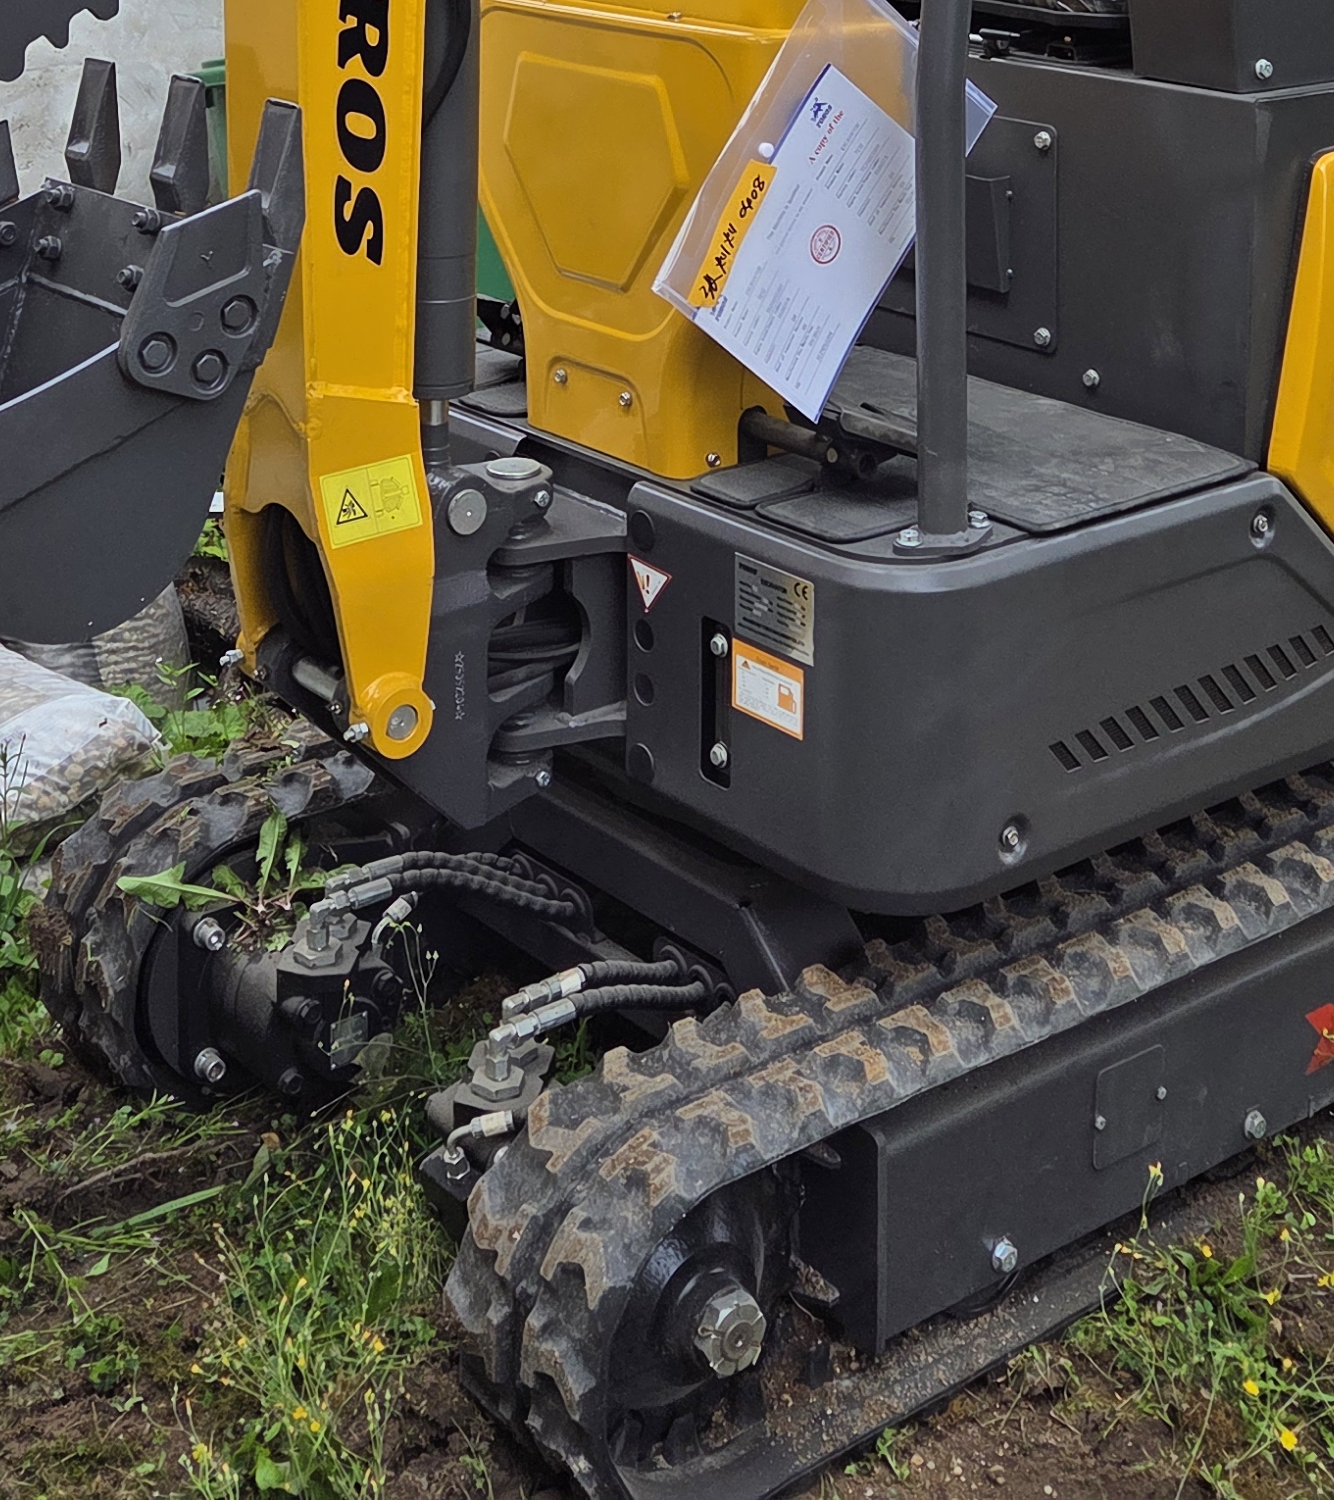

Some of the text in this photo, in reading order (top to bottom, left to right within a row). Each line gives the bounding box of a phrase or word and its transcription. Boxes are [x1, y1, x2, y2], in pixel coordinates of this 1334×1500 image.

[808, 110, 844, 165] A copy of the
[815, 229, 836, 263] CERTIFIED
